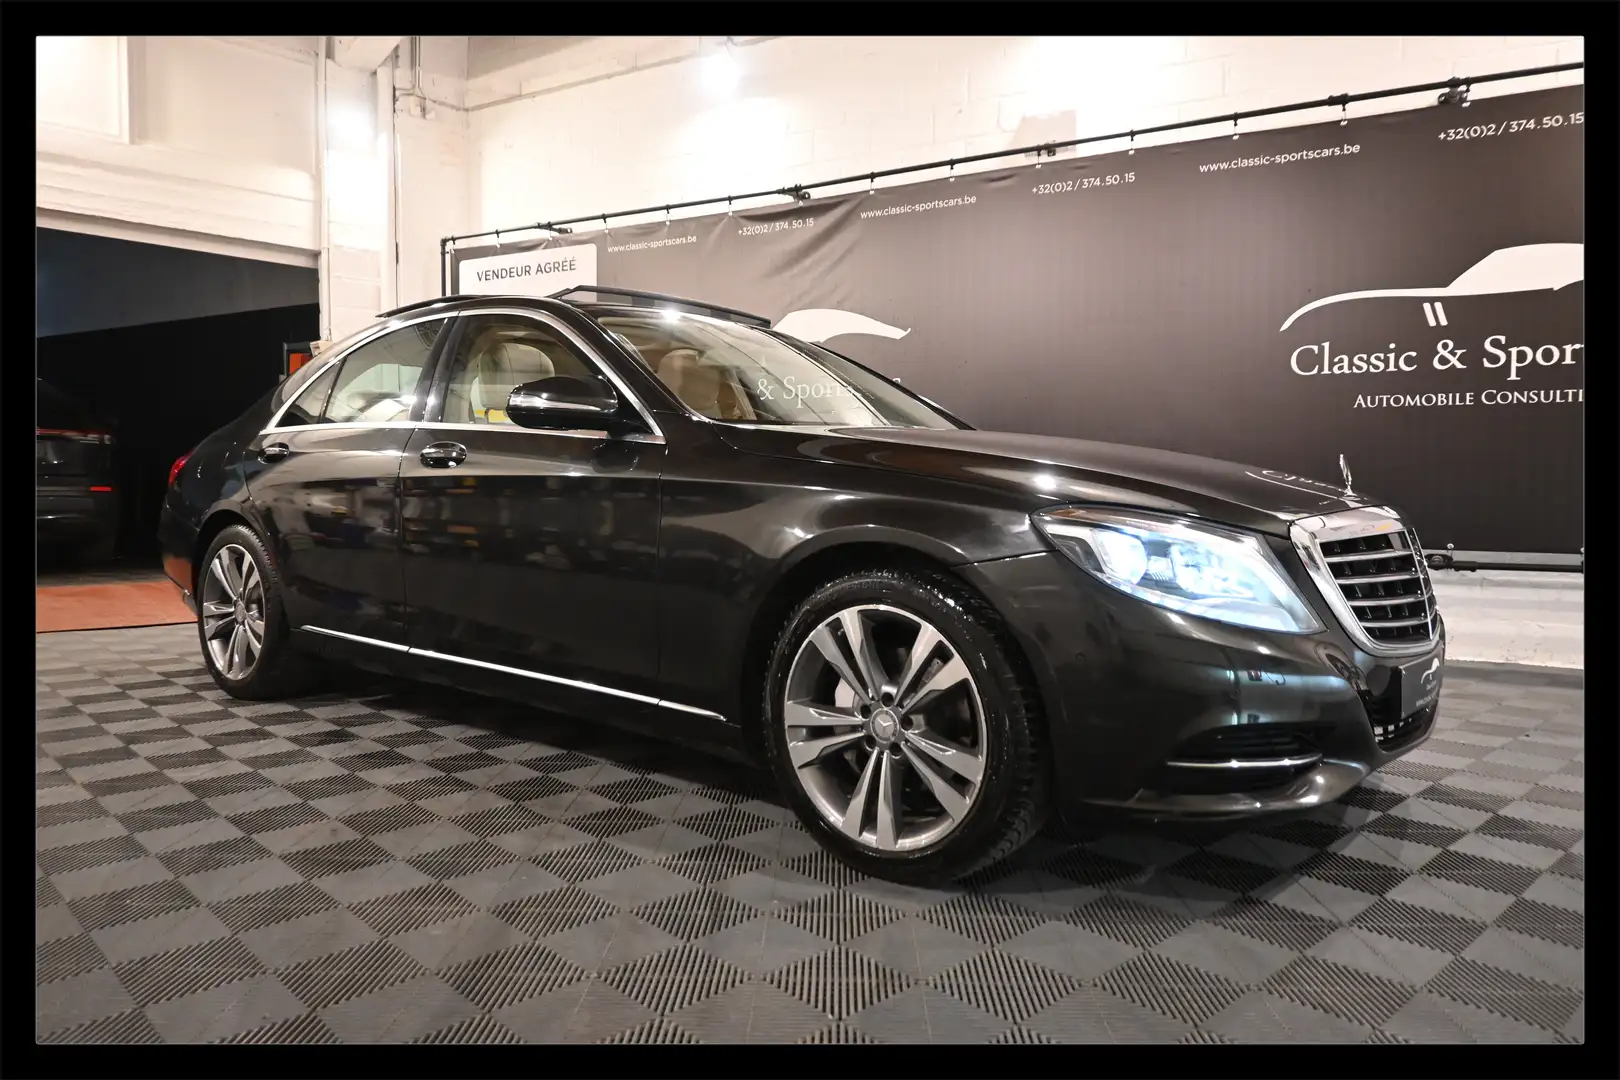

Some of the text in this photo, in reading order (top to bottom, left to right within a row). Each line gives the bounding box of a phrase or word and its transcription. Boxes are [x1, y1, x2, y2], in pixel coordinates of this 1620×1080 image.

[1199, 143, 1361, 173] www.classic-sportscars.be
[860, 194, 977, 220] www.classic-sportscars.be
[607, 234, 697, 253] www.classic-sportscars.be
[477, 256, 577, 282] VENDEUR AGRÉÉ
[1290, 335, 1584, 380] Classic & Spor
[756, 378, 775, 400] &
[1353, 392, 1475, 408] AUTOMOBILE
